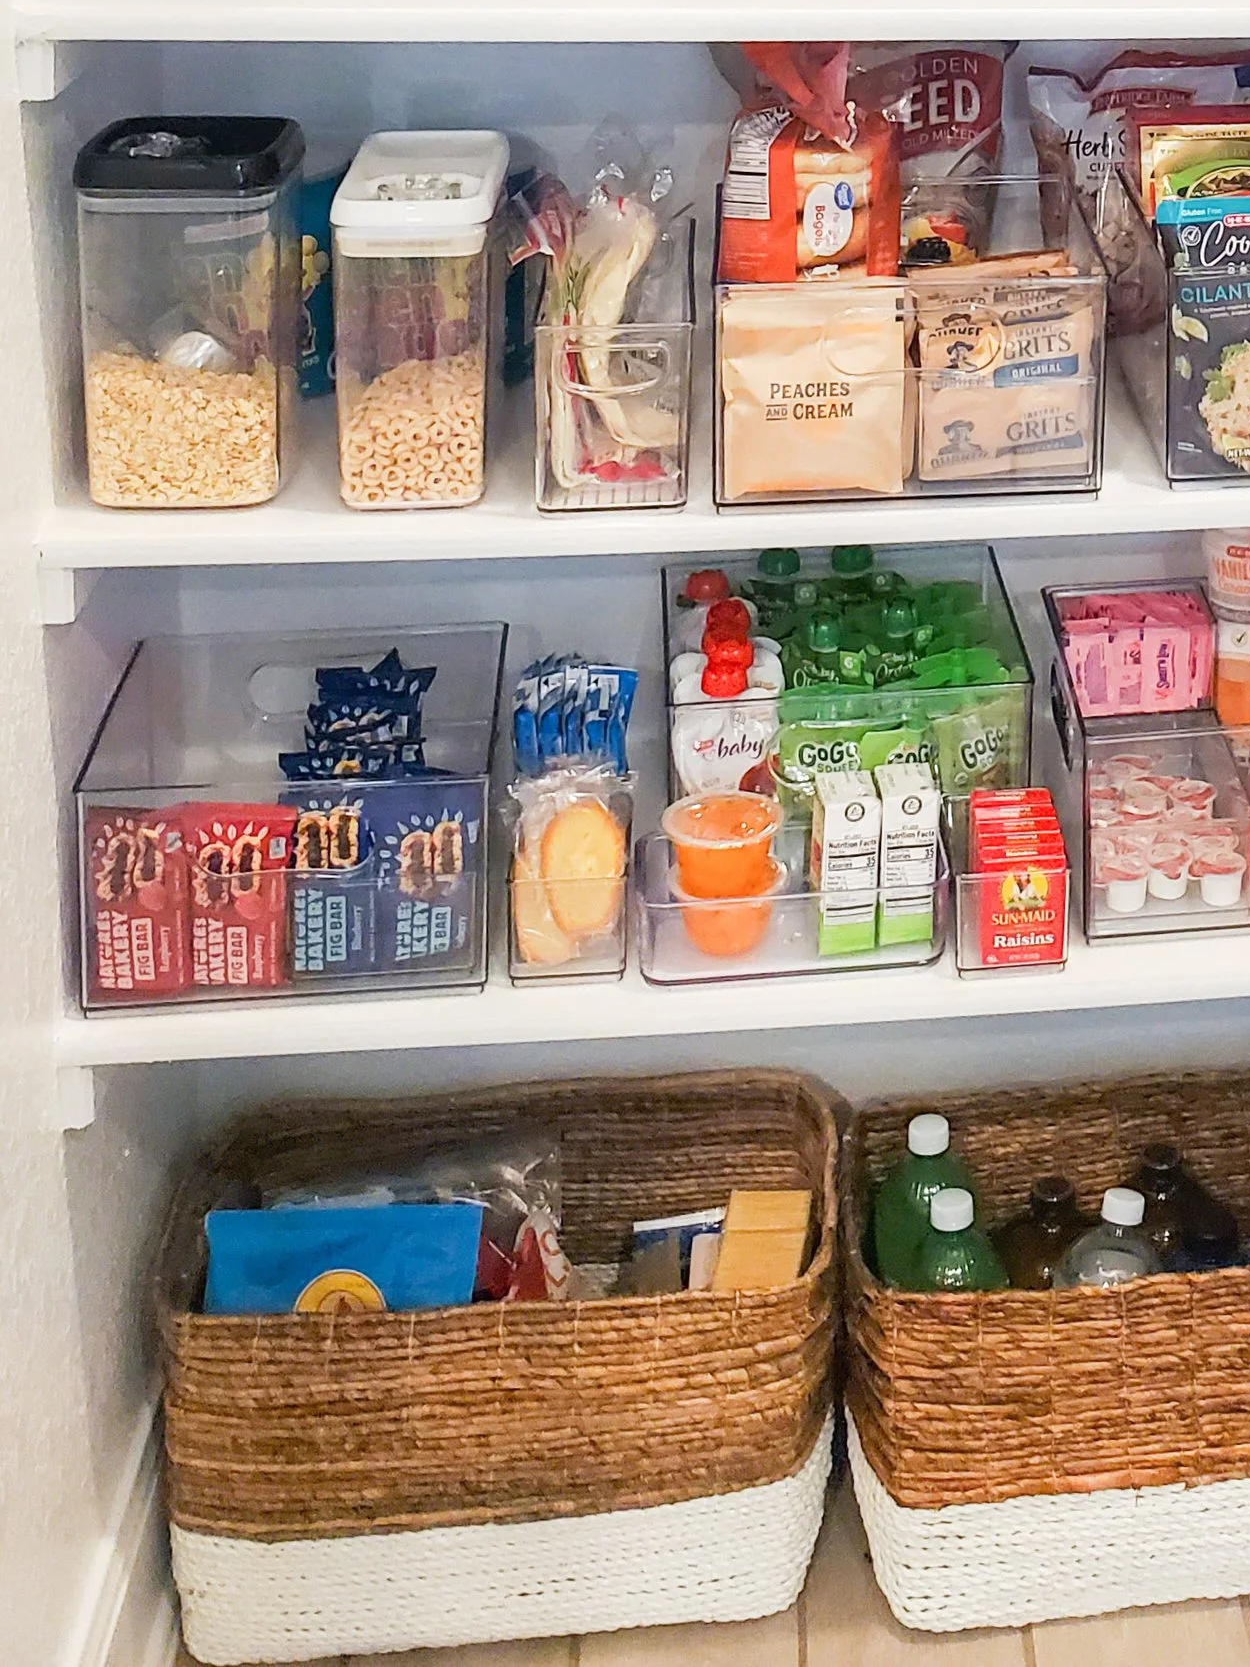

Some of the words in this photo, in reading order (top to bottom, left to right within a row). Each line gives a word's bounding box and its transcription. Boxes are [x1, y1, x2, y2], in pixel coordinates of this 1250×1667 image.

[901, 57, 978, 82] OLDEN
[1003, 330, 1072, 360] GRITS
[1011, 362, 1063, 379] ORIGINAL
[770, 381, 850, 399] PEACHES
[765, 406, 788, 418] AND
[792, 402, 854, 420] CREAM
[1006, 411, 1077, 442] GRITS
[718, 734, 764, 760] baby
[829, 841, 858, 849] Nutrition
[858, 838, 877, 847] Facts
[886, 832, 915, 841] Nutrition
[916, 830, 935, 839] Facts
[828, 861, 853, 869] Calories
[886, 852, 911, 860] Calories
[330, 900, 343, 929] BAR
[434, 911, 447, 938] BAR
[135, 922, 149, 952] BAR
[307, 888, 324, 971] BAKERY
[993, 933, 1055, 949] Raisins
[111, 910, 133, 990] BAKERY
[231, 931, 243, 957] BAR
[330, 934, 343, 957] FIG
[138, 954, 151, 977] FIG
[231, 959, 244, 981] FIG
